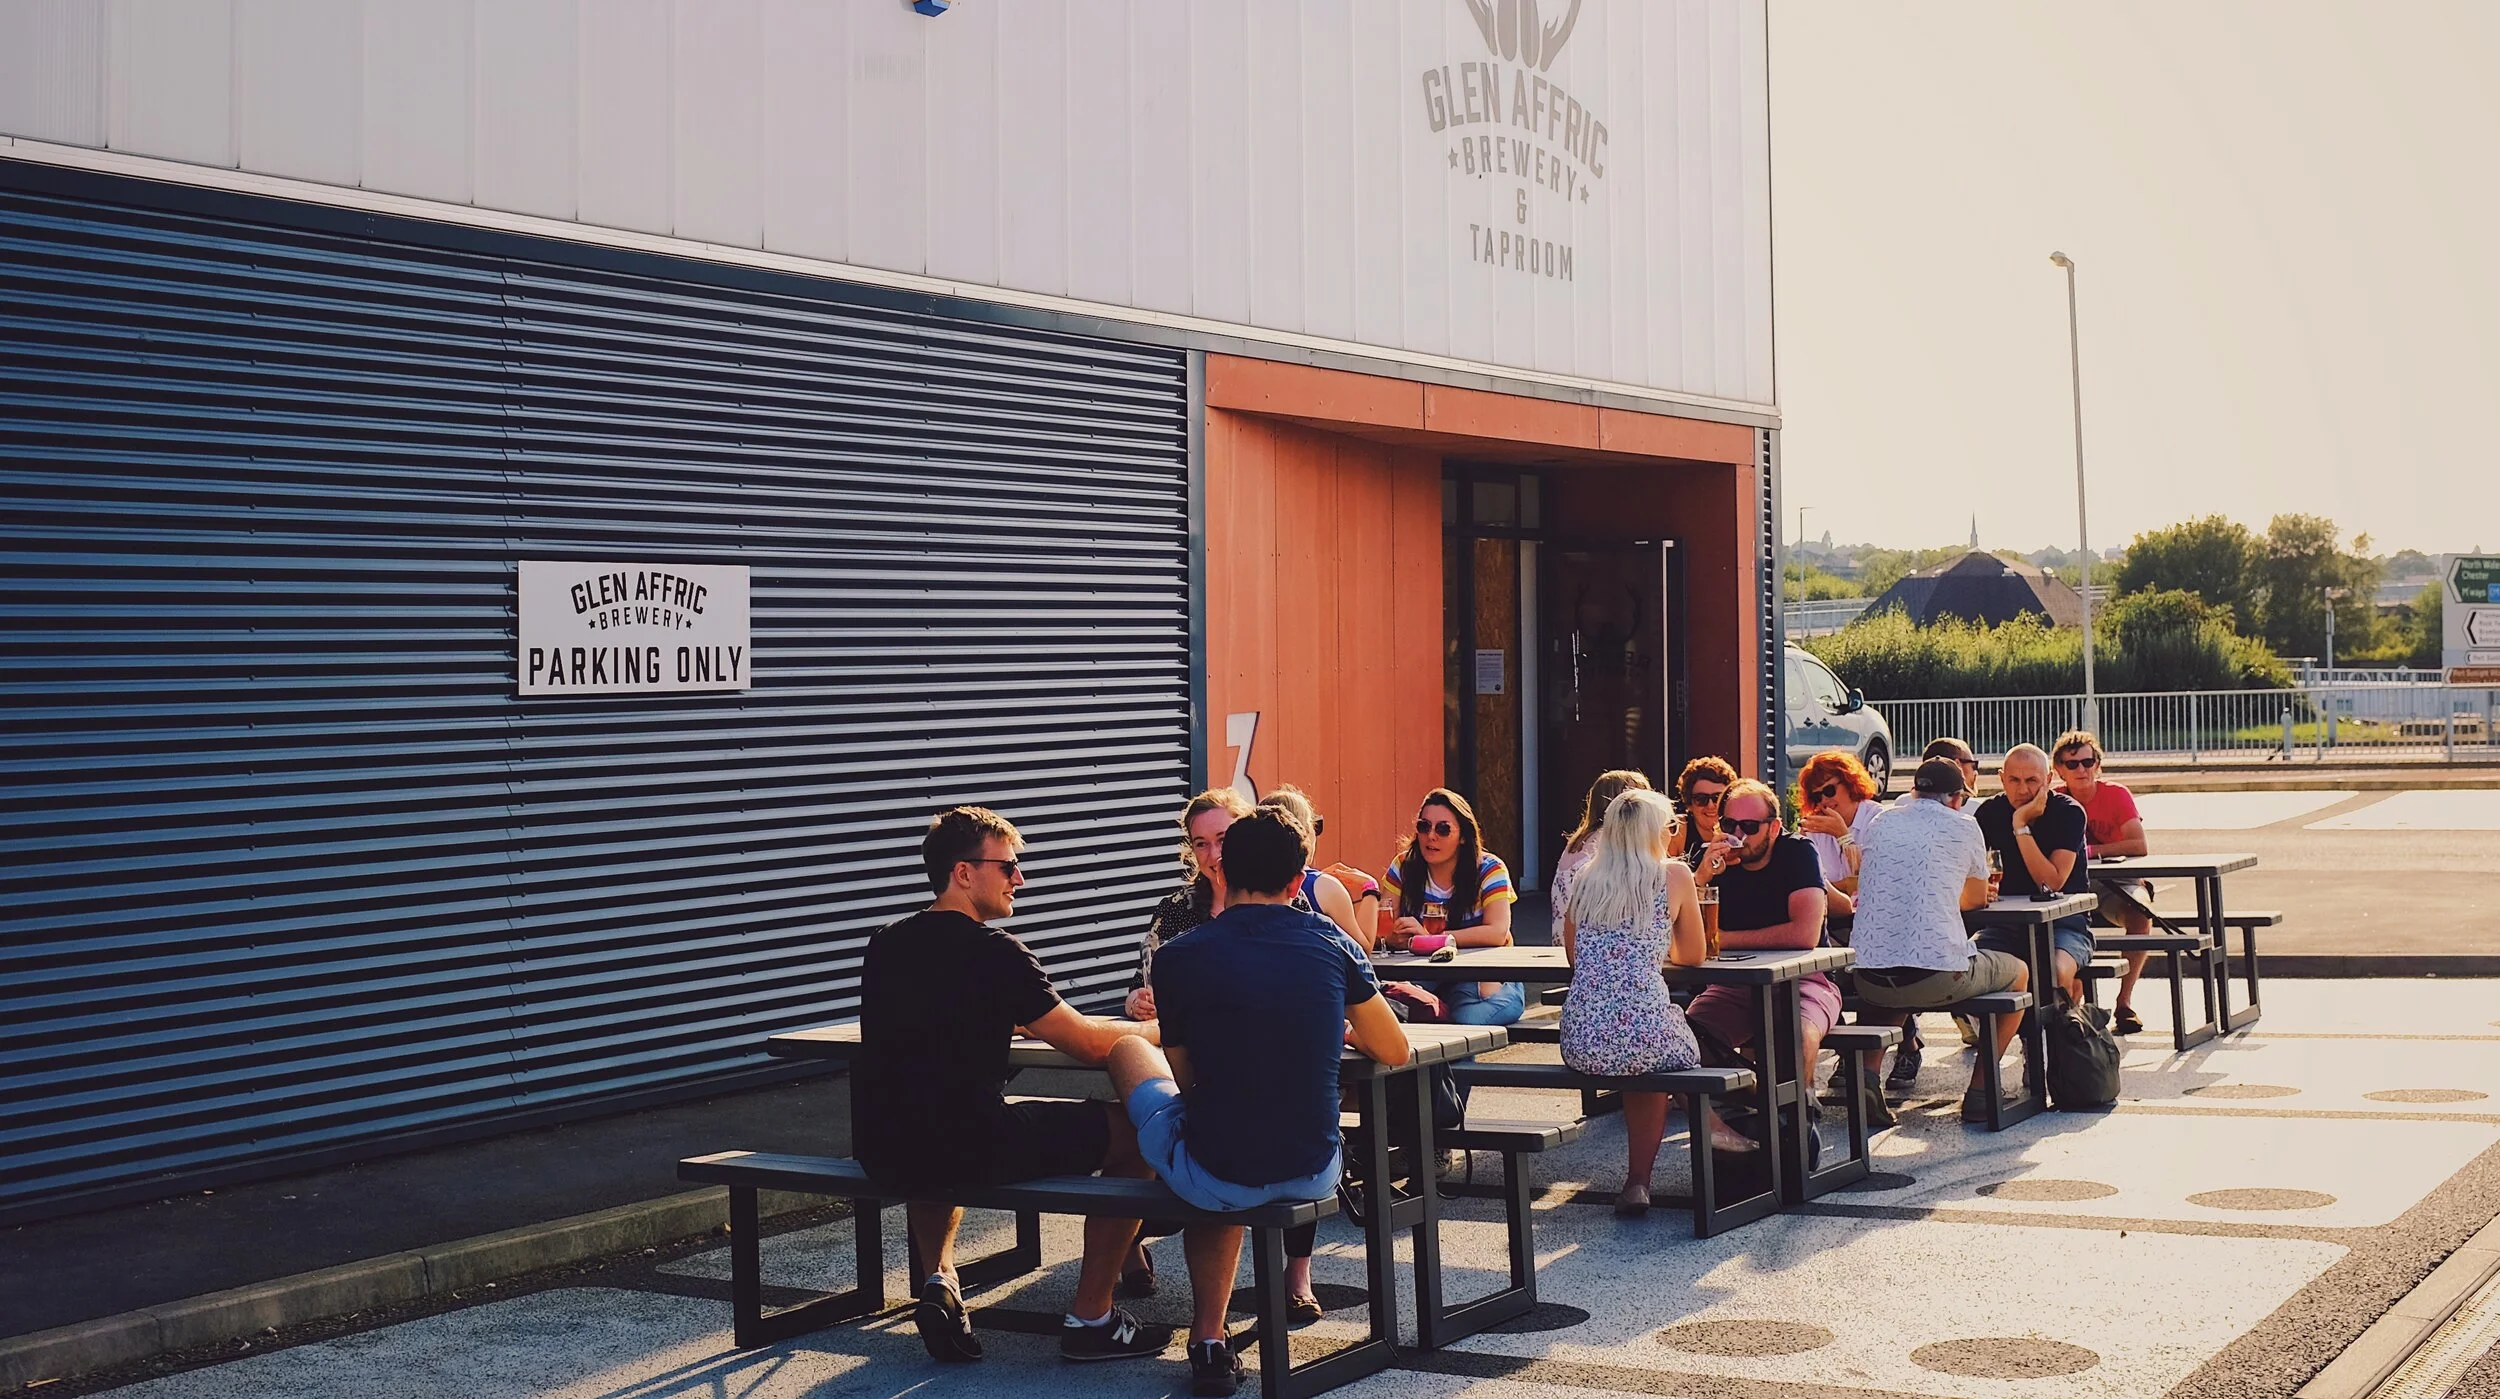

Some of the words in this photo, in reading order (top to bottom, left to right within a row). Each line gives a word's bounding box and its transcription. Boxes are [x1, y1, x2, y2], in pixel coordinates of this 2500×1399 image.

[1422, 62, 1501, 133] GLEN
[1512, 69, 1608, 179] AFFRIC
[1462, 136, 1577, 202] BREWERY
[1516, 188, 1527, 224] &
[1470, 223, 1573, 281] TAPROOM
[571, 572, 628, 615] GLEN
[635, 571, 708, 615] AFFRIC
[599, 606, 683, 630] BREWERY
[529, 647, 660, 686] PARKING
[677, 646, 742, 683] ONLY
